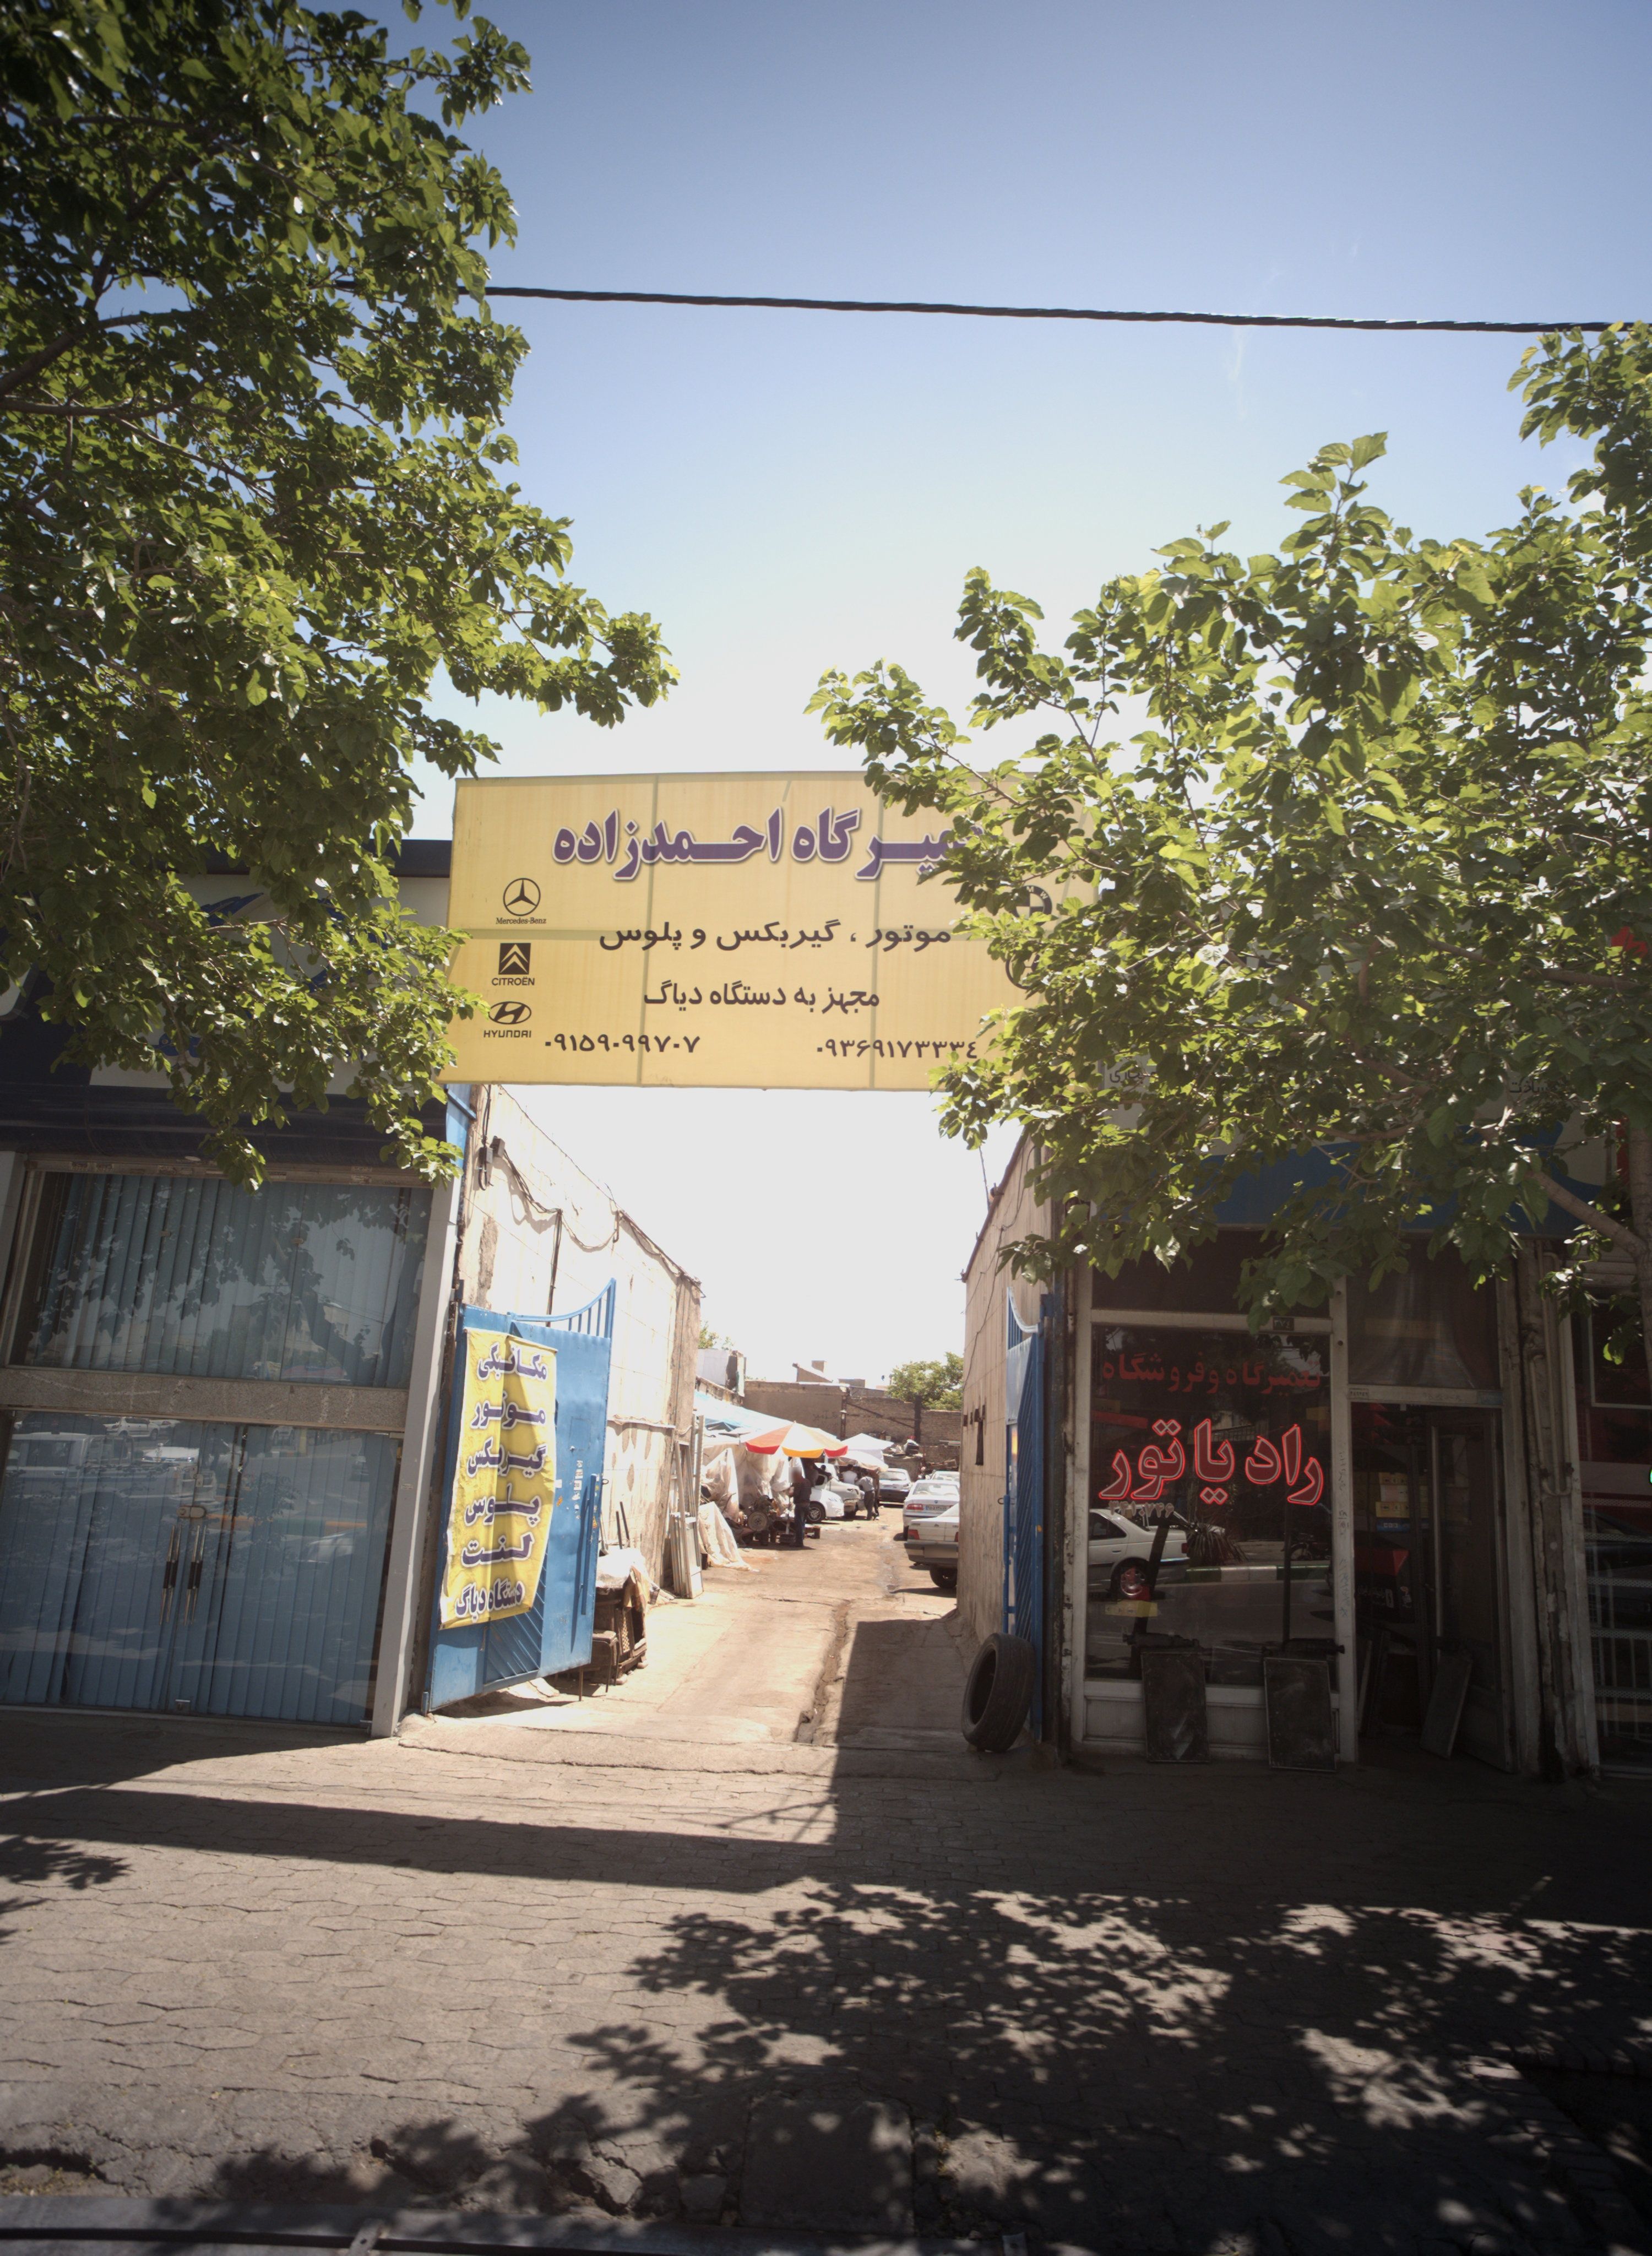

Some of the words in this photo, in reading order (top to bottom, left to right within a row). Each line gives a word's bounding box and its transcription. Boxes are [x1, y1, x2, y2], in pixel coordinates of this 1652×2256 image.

[552, 806, 784, 882] احمدزاده
[599, 921, 682, 951] پلوس
[691, 926, 707, 950] و
[716, 919, 841, 951] گیربکس
[491, 977, 535, 986] CITROËN
[644, 979, 703, 1012] دیاگ
[709, 980, 786, 1006] دستگاه
[794, 987, 817, 1013] به
[822, 986, 880, 1014] مجهز
[483, 1029, 532, 1039] HYUNDAI
[476, 1342, 548, 1381] مکانیکی
[1102, 1351, 1206, 1393] فروشگاه
[1226, 1358, 1322, 1397] تعمیرگاه
[1207, 1369, 1220, 1394] و
[470, 1390, 546, 1430] موتور
[466, 1436, 548, 1478] گیربکس
[464, 1483, 542, 1527] پلوس
[460, 1531, 534, 1569] لنت
[454, 1583, 486, 1623] دیاگ
[487, 1577, 526, 1613] دستگاه
